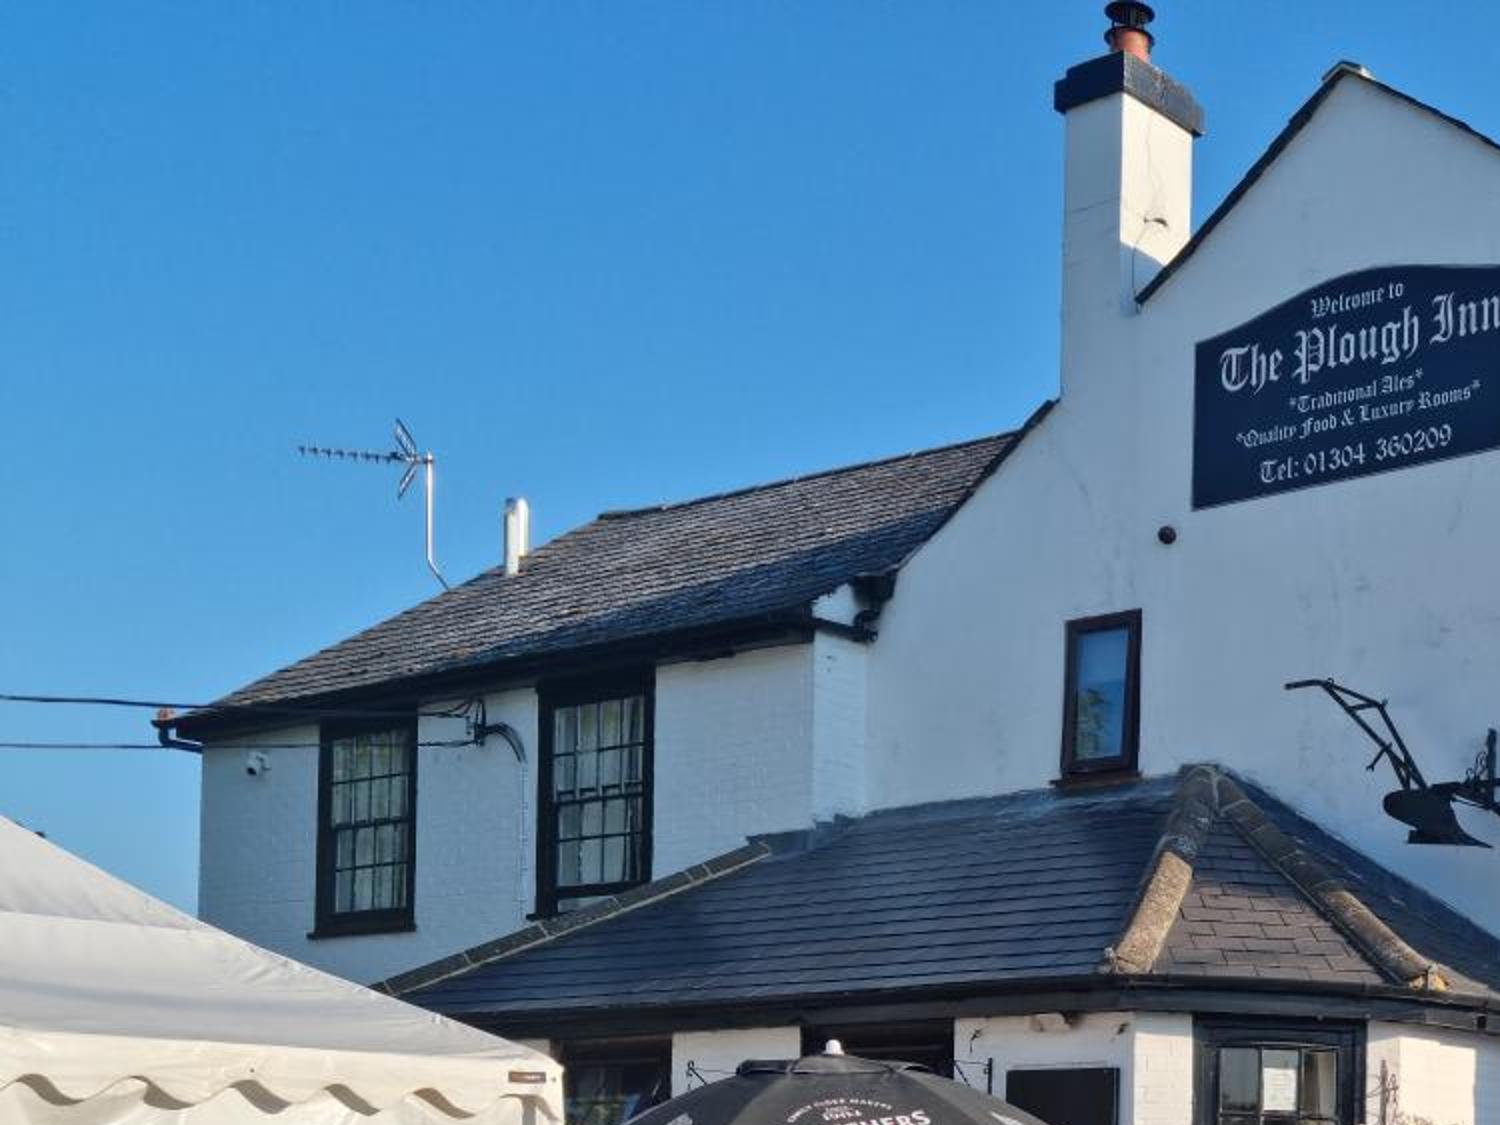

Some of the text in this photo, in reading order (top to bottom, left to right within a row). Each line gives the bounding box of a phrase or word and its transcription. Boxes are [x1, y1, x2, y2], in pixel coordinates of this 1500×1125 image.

[1311, 282, 1404, 318] Welcome to
[1220, 344, 1283, 395] The
[1292, 305, 1419, 384] Plough
[1299, 414, 1336, 440] Food
[1341, 410, 1354, 427] &
[1359, 400, 1414, 423] Luxury
[1260, 424, 1452, 483] Tel: 01304 360209
